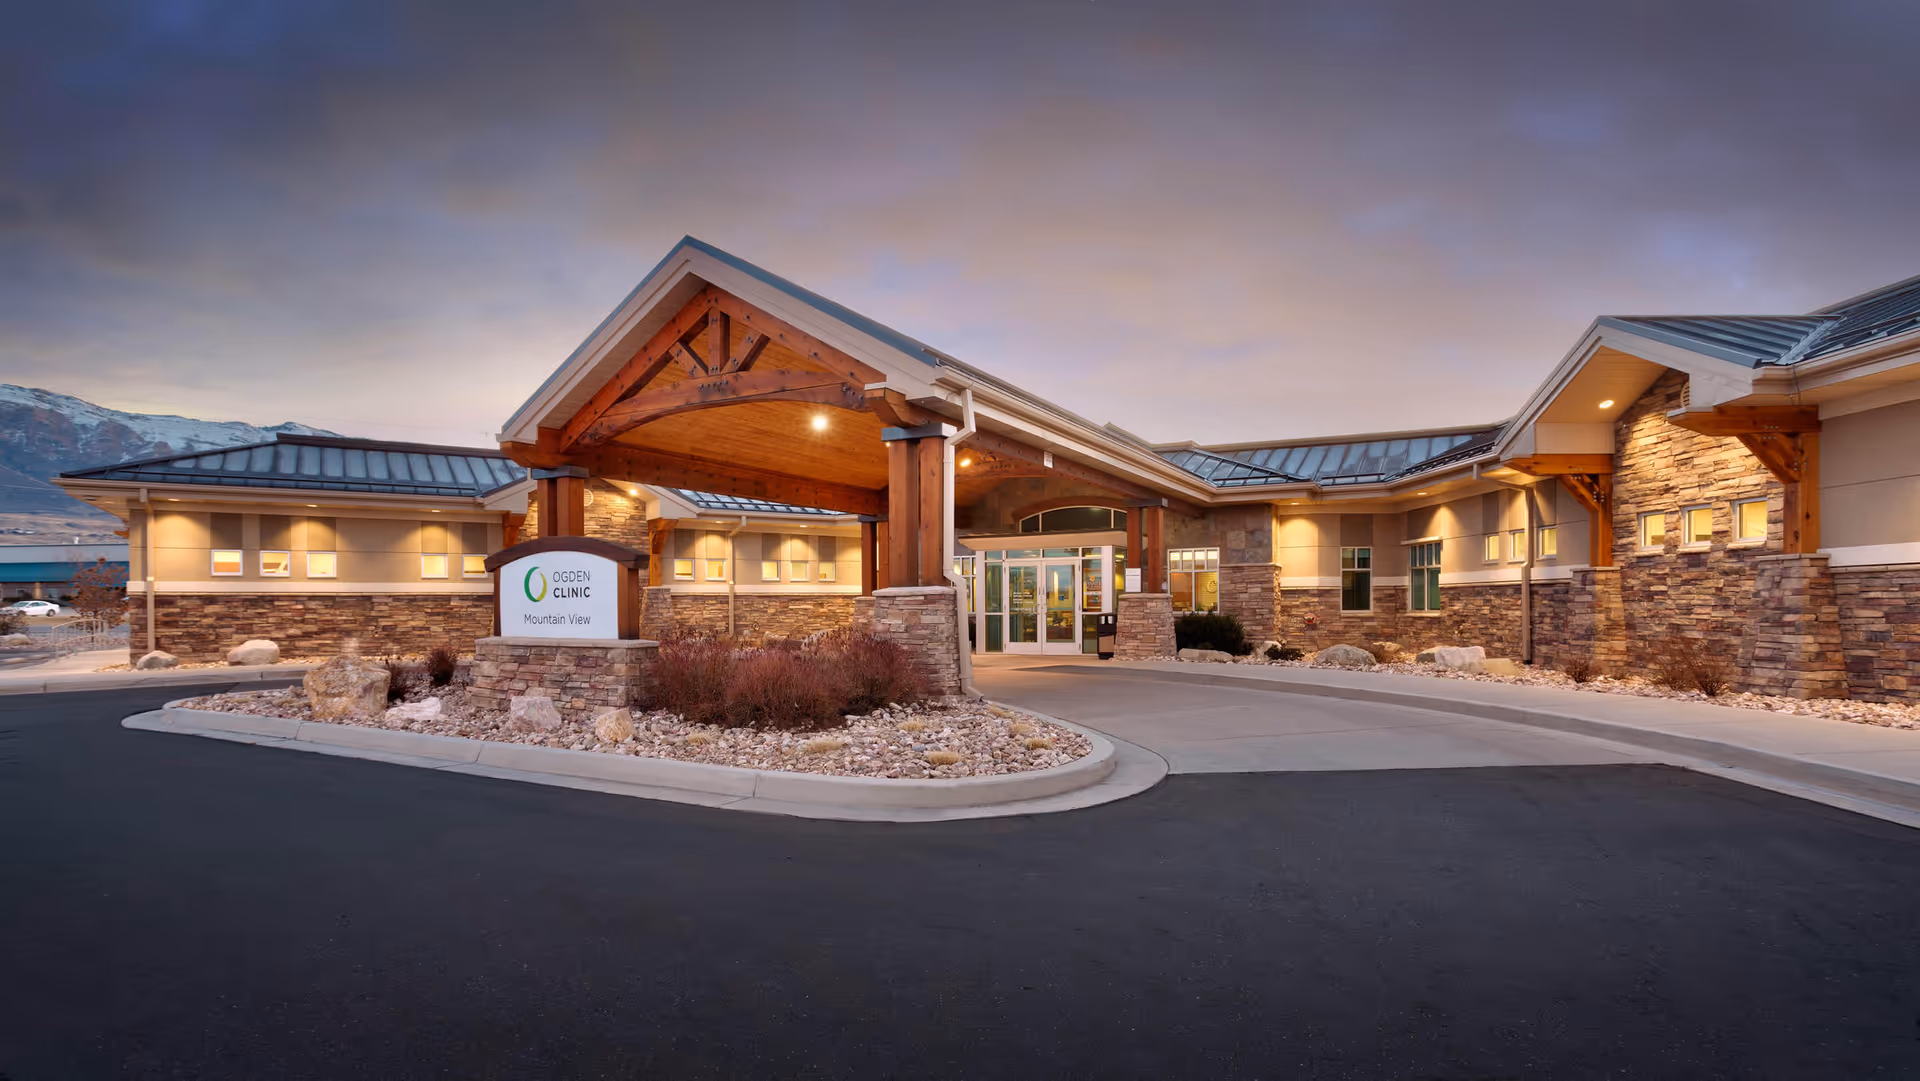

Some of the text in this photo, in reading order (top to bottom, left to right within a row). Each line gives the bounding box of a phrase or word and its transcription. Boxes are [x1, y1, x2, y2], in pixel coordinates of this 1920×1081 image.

[553, 570, 591, 583] OGDEN
[553, 586, 591, 598] CLINIC
[524, 613, 591, 625] Mountain View
